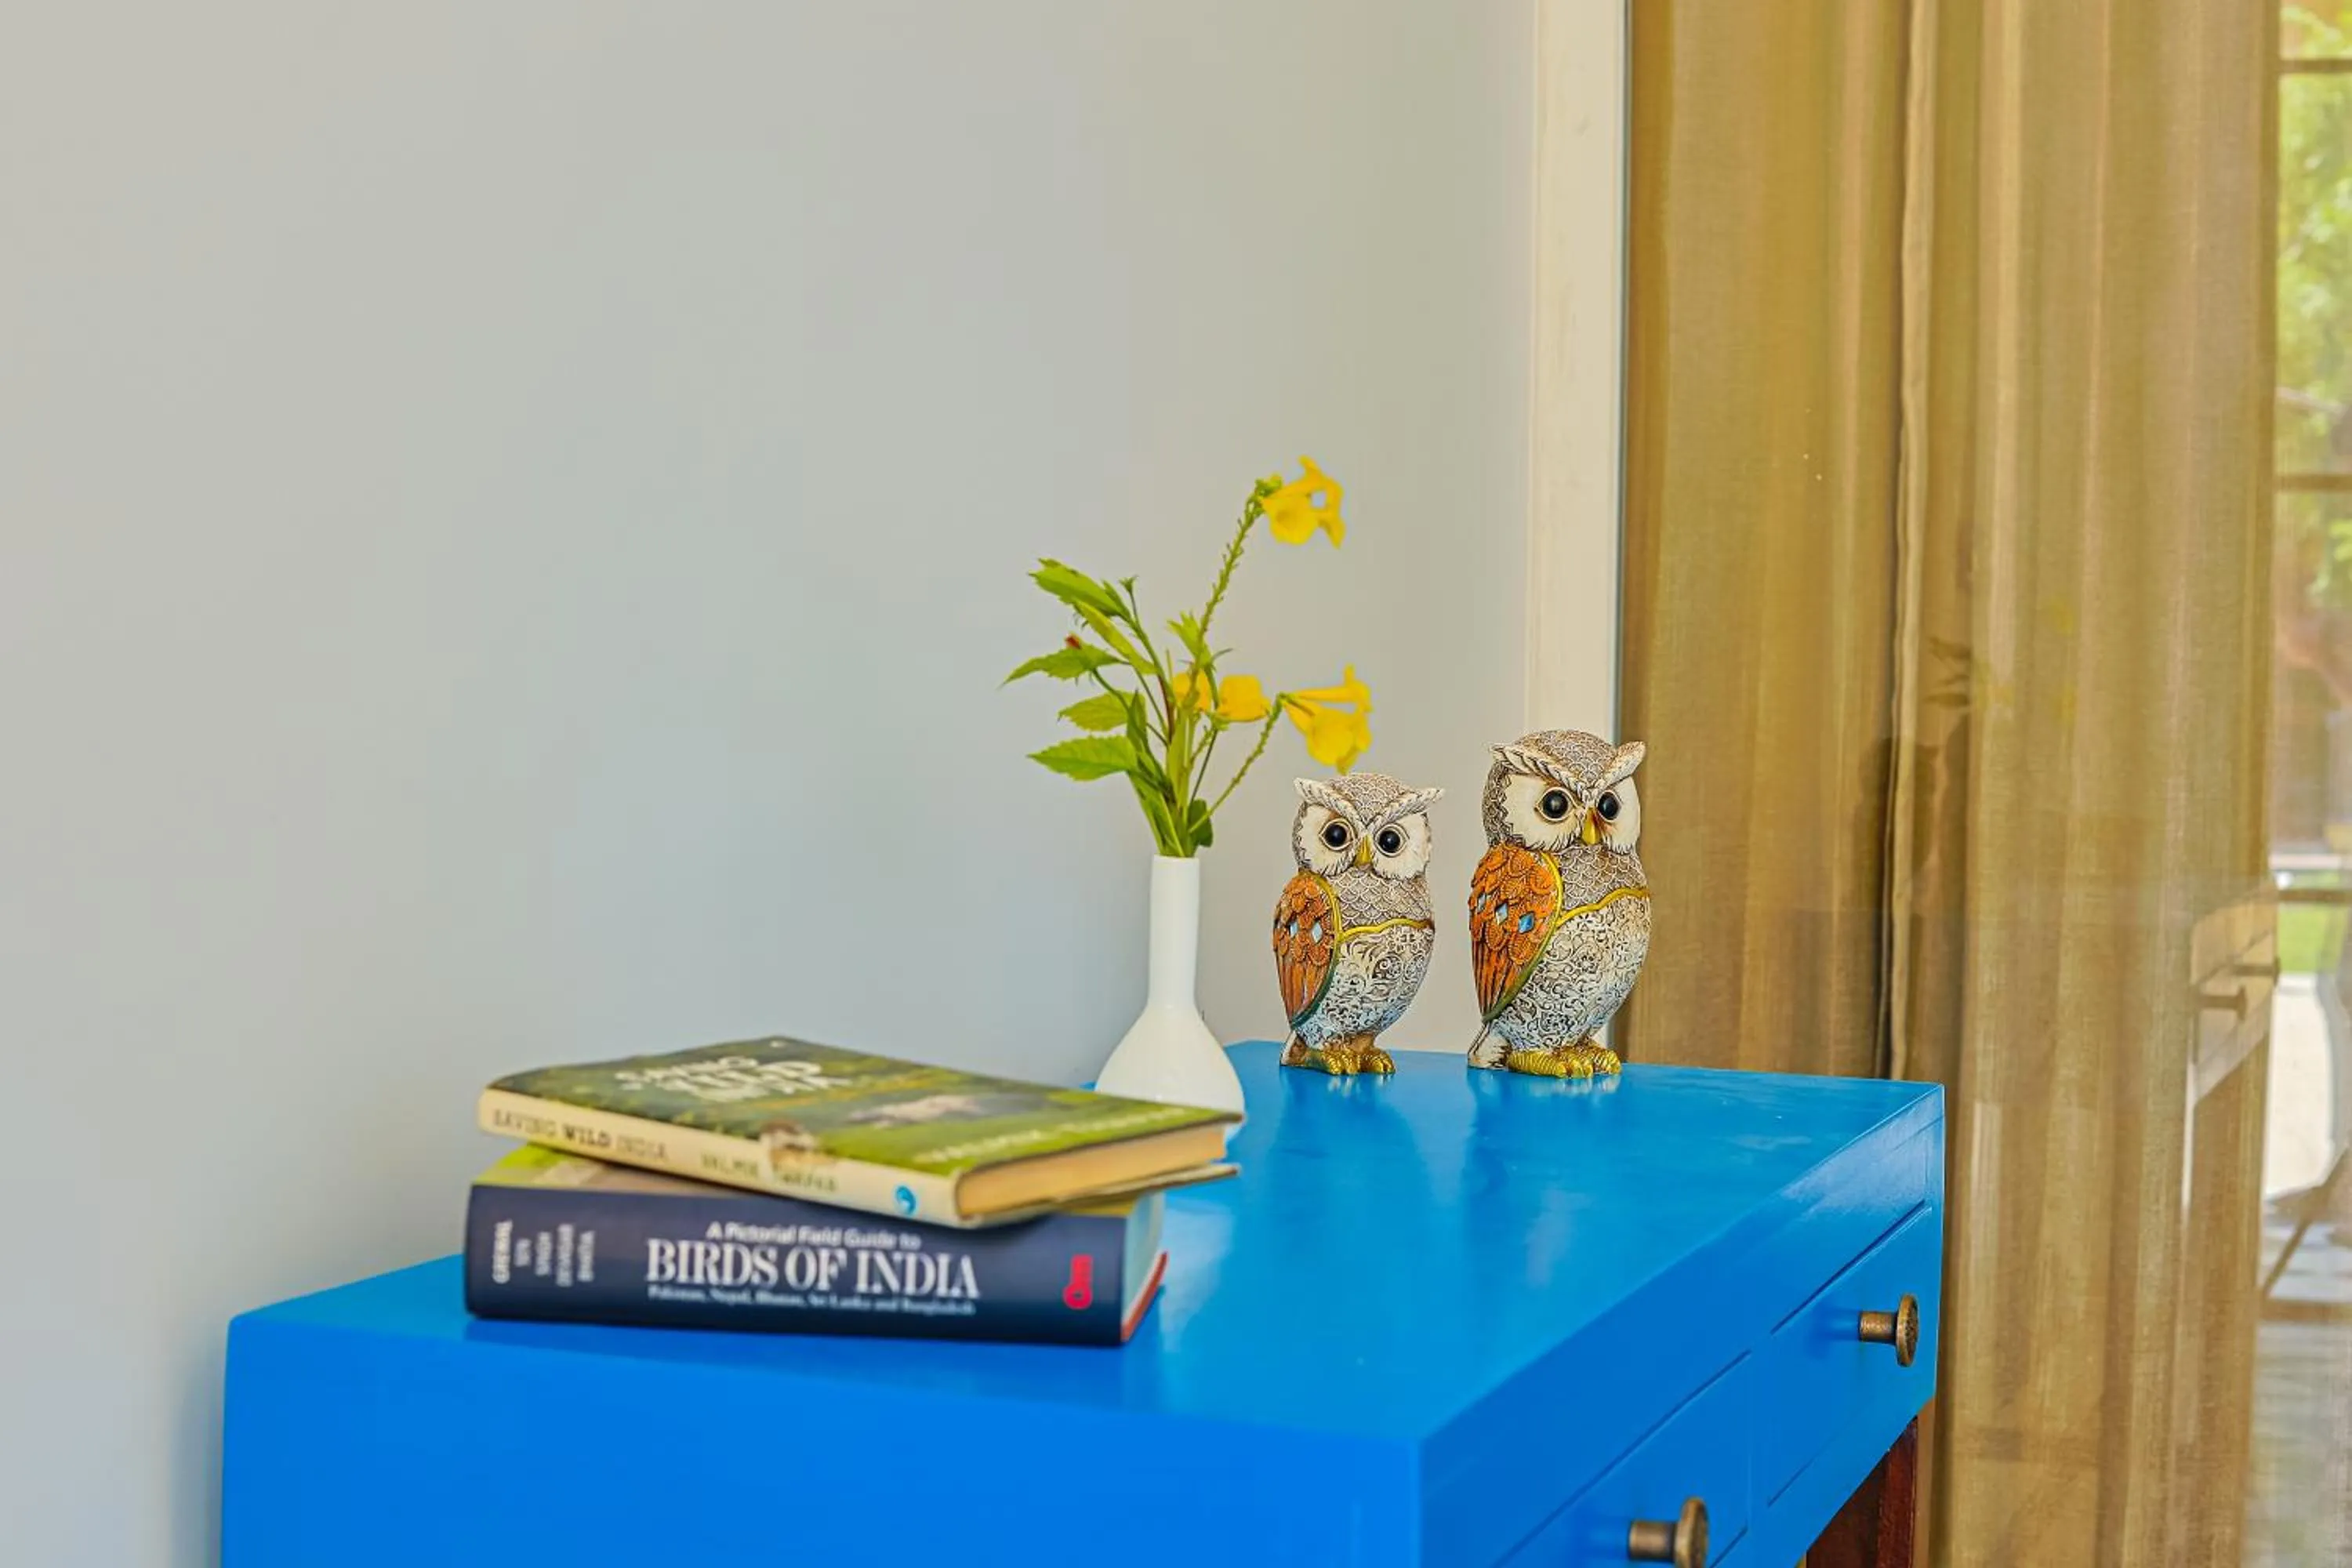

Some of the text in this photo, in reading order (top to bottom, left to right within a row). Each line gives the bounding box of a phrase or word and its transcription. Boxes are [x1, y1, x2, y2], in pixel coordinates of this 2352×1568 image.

[562, 1123, 612, 1148] WILD
[705, 1220, 723, 1240] A
[725, 1221, 797, 1244] Pictorial
[844, 1228, 897, 1249] Guide
[899, 1232, 922, 1250] to
[645, 1238, 779, 1288] BIRDS
[785, 1243, 848, 1291] OF
[853, 1249, 980, 1299] INDIA
[873, 1298, 899, 1312] and
